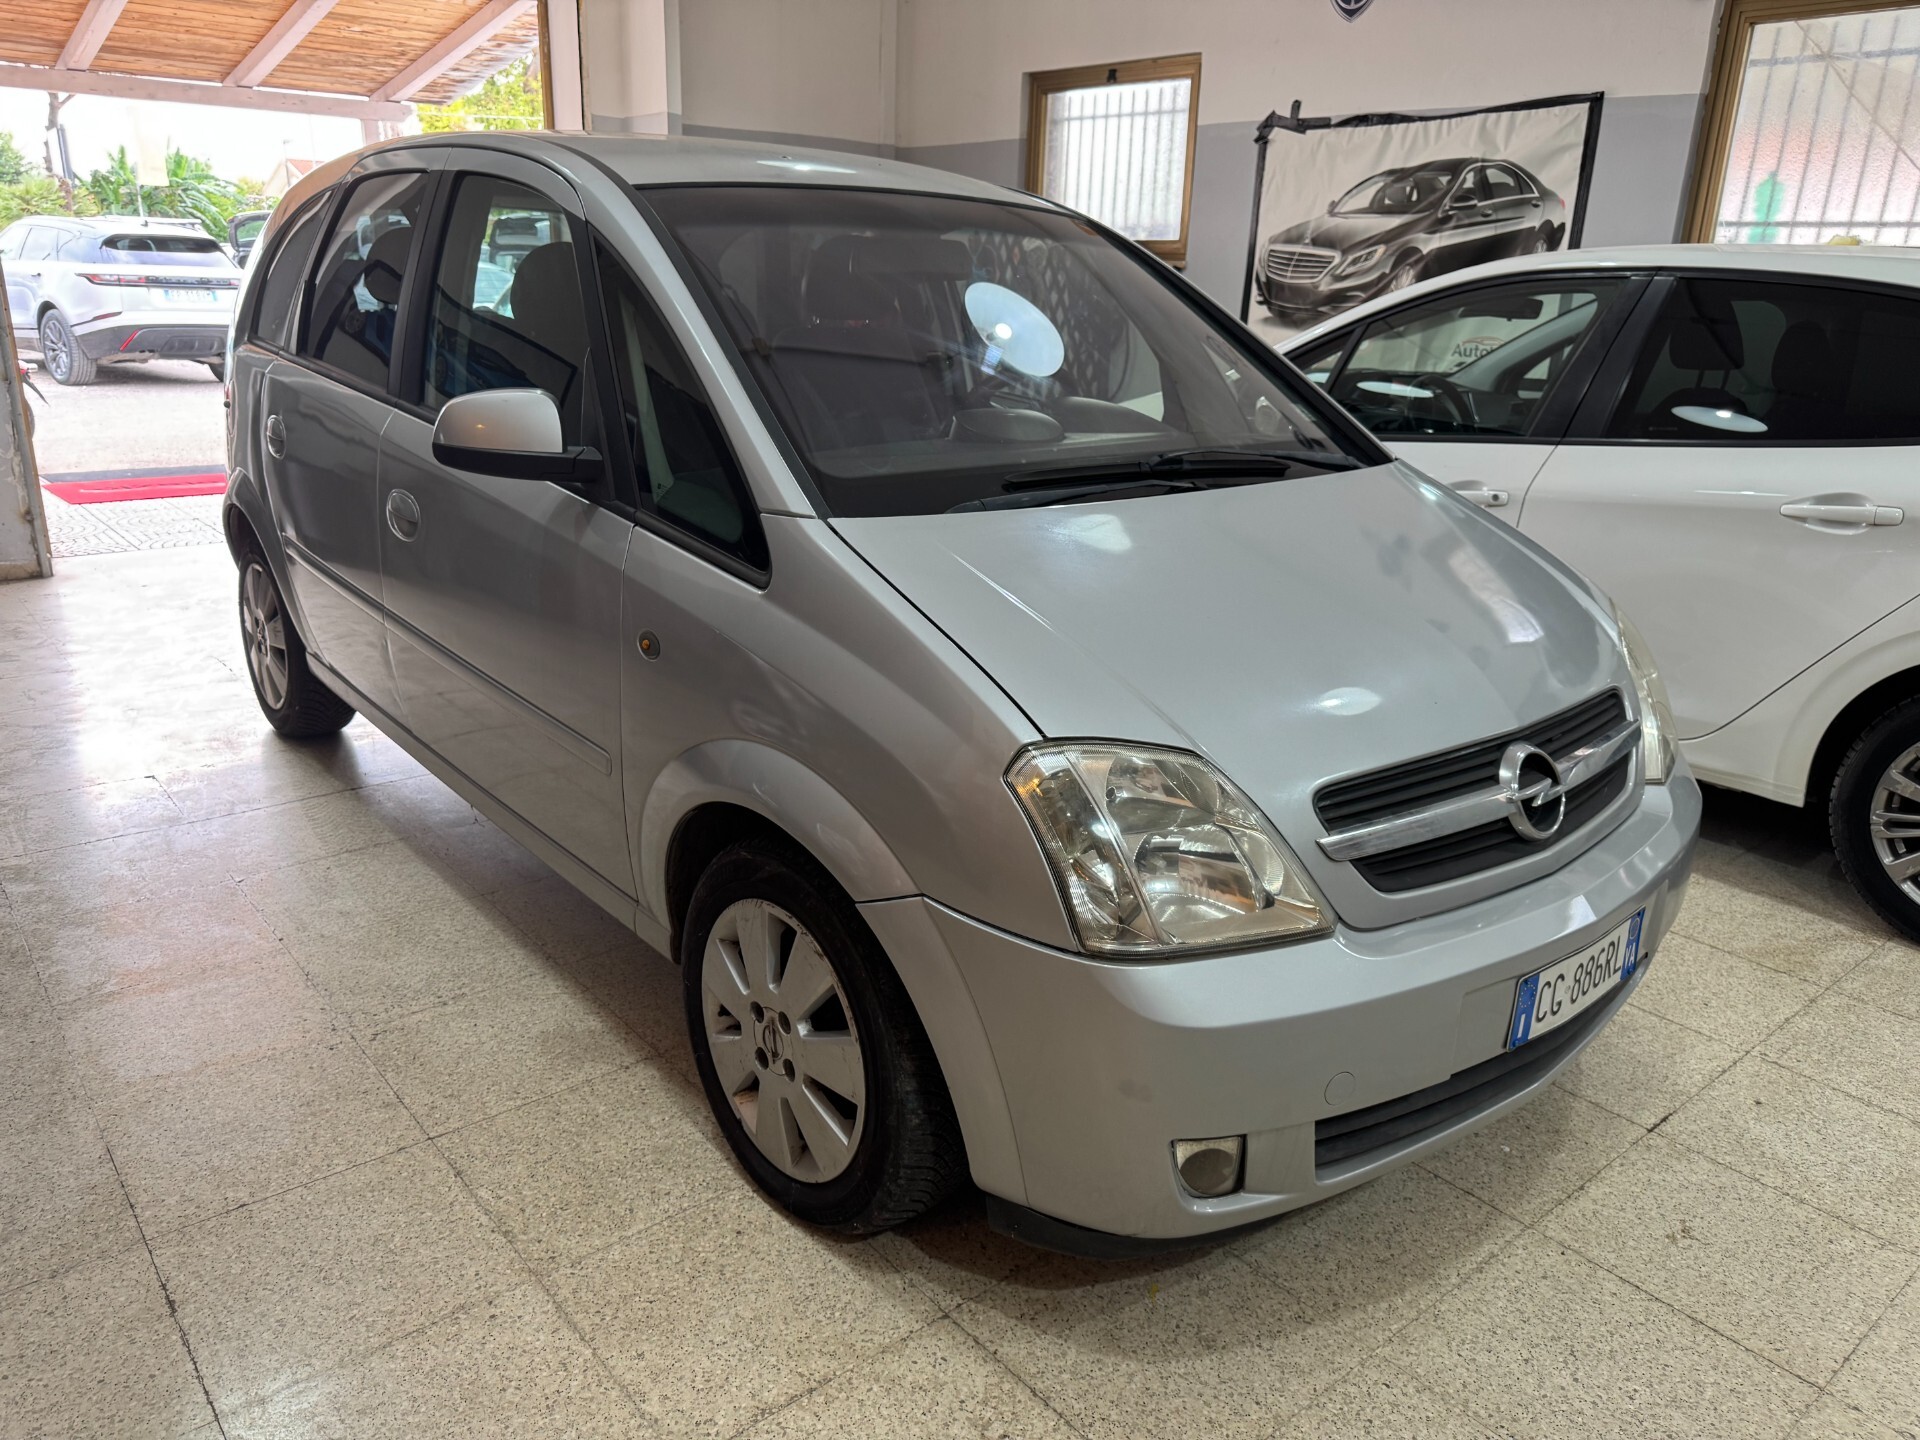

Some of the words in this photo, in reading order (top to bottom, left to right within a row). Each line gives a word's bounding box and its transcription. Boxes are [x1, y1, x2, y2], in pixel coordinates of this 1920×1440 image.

[1451, 343, 1493, 358] Auto
[1536, 973, 1565, 1023] CG
[1570, 935, 1622, 1005] 886RL
